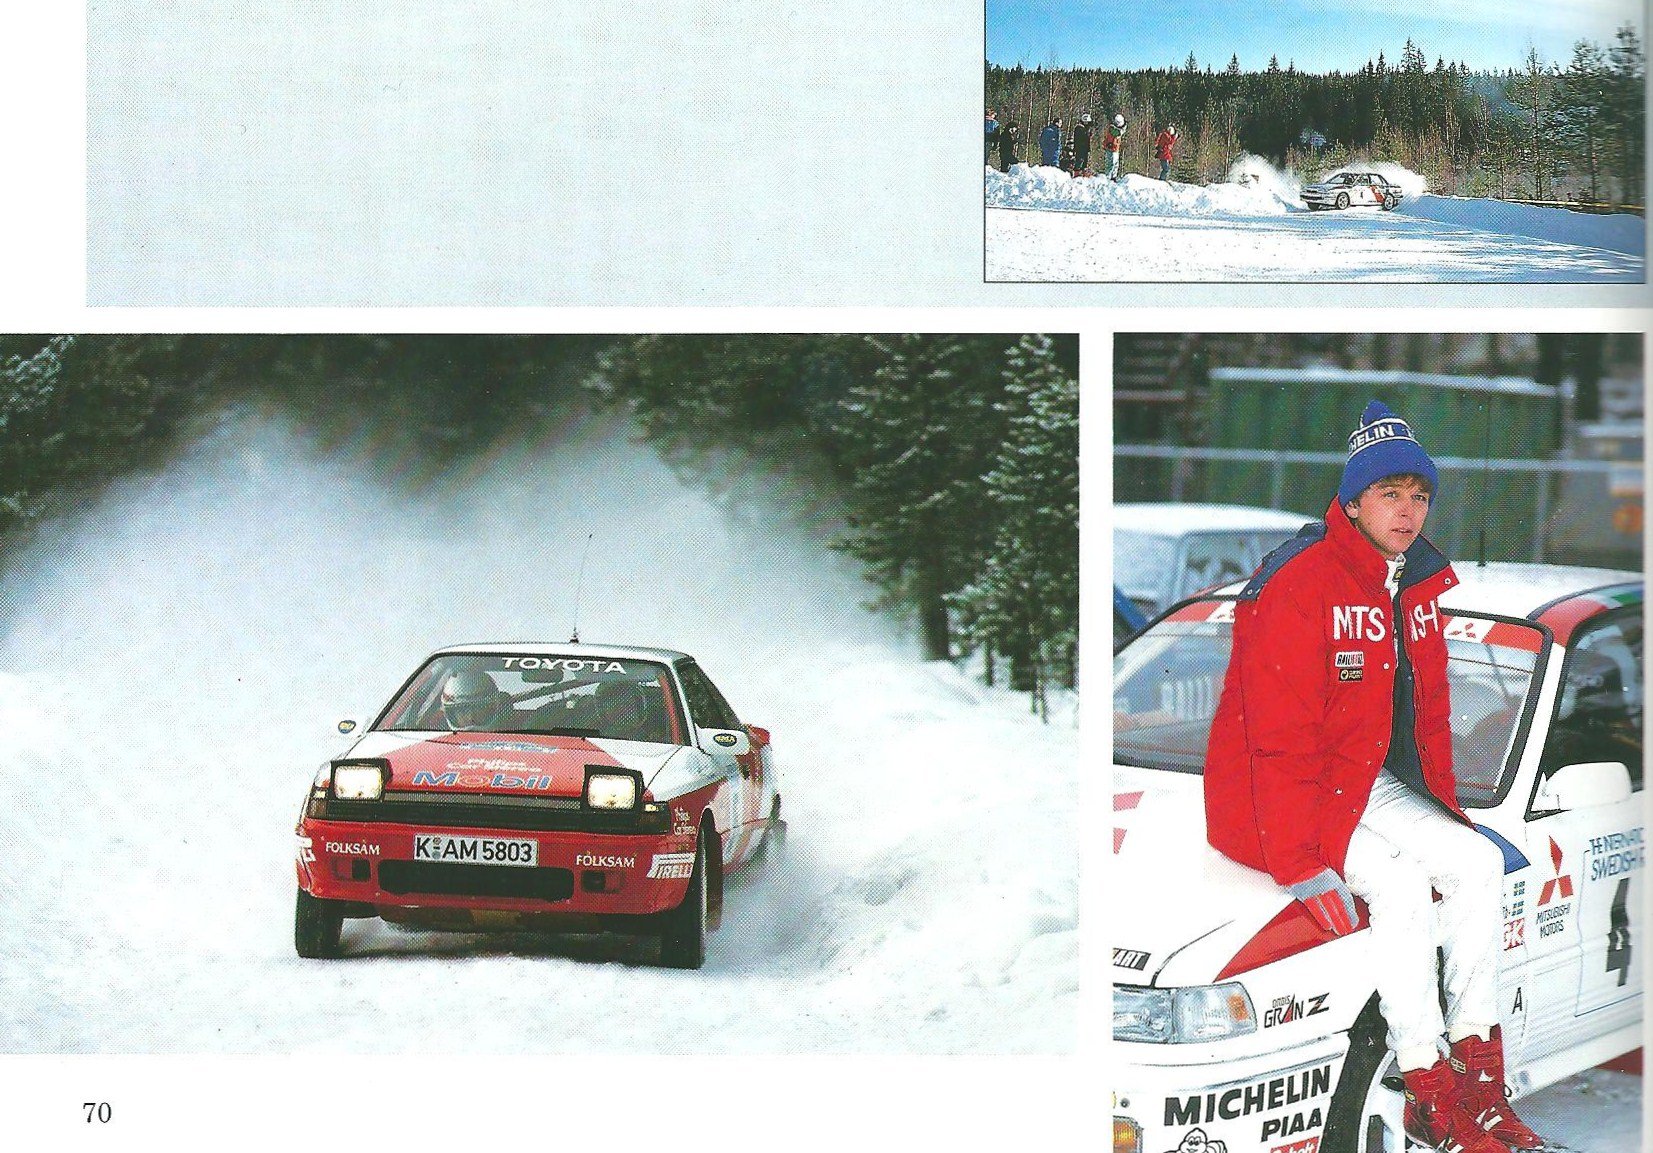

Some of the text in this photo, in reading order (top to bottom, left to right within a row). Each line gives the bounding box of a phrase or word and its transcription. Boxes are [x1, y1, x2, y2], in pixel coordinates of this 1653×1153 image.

[1348, 424, 1395, 455] HELIN
[501, 656, 627, 675] TOYOTA
[412, 770, 553, 791] Mobil
[325, 841, 381, 856] FOLKSAM
[482, 840, 532, 862] 5803
[575, 853, 635, 869] FOLKSAM
[1536, 902, 1572, 925] MITSUBISHI
[1539, 919, 1565, 940] MOTORS
[1606, 877, 1633, 987] 4
[1113, 949, 1148, 969] ART
[1264, 992, 1330, 1029] GRAN Z
[1511, 986, 1523, 1015] A
[1164, 1064, 1331, 1127] MICHELIN
[82, 1102, 112, 1124] 70
[1260, 1107, 1322, 1143] PIAA
